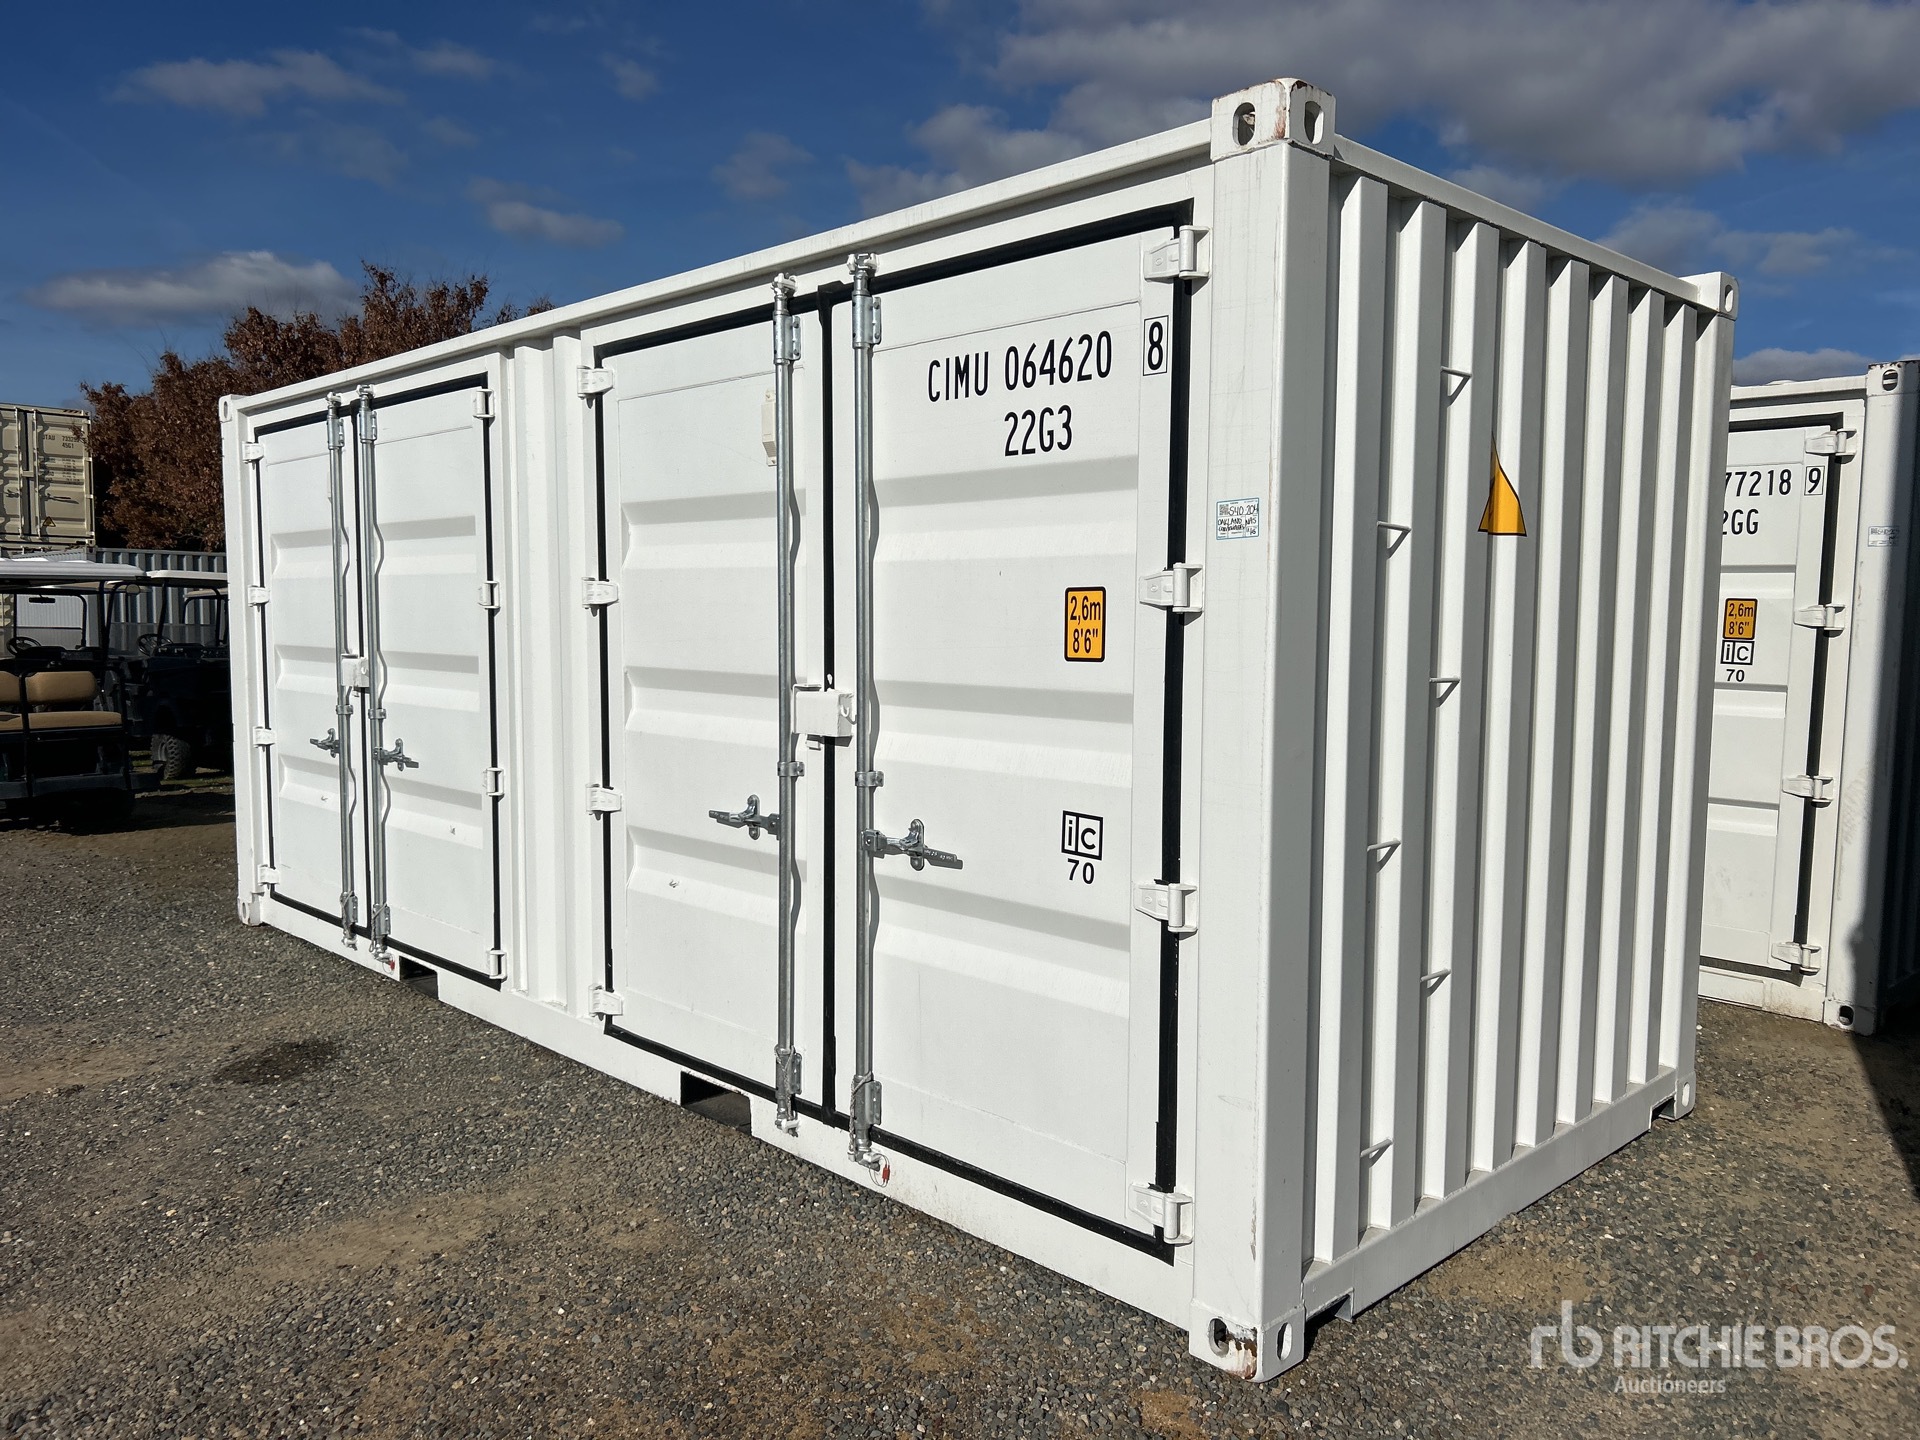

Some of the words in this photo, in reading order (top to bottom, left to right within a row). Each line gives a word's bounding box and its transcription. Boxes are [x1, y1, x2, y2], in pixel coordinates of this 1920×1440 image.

[928, 351, 989, 402] CIMU
[1004, 330, 1112, 391] 064620
[1147, 321, 1164, 371] 8
[1004, 404, 1072, 457] 22G3
[1807, 467, 1821, 494] 9
[1070, 595, 1101, 625] 2,6m
[1728, 602, 1754, 619] 2,6m
[1072, 628, 1098, 654] 8'6"
[1726, 668, 1745, 682] 70
[1067, 858, 1095, 885] 70
